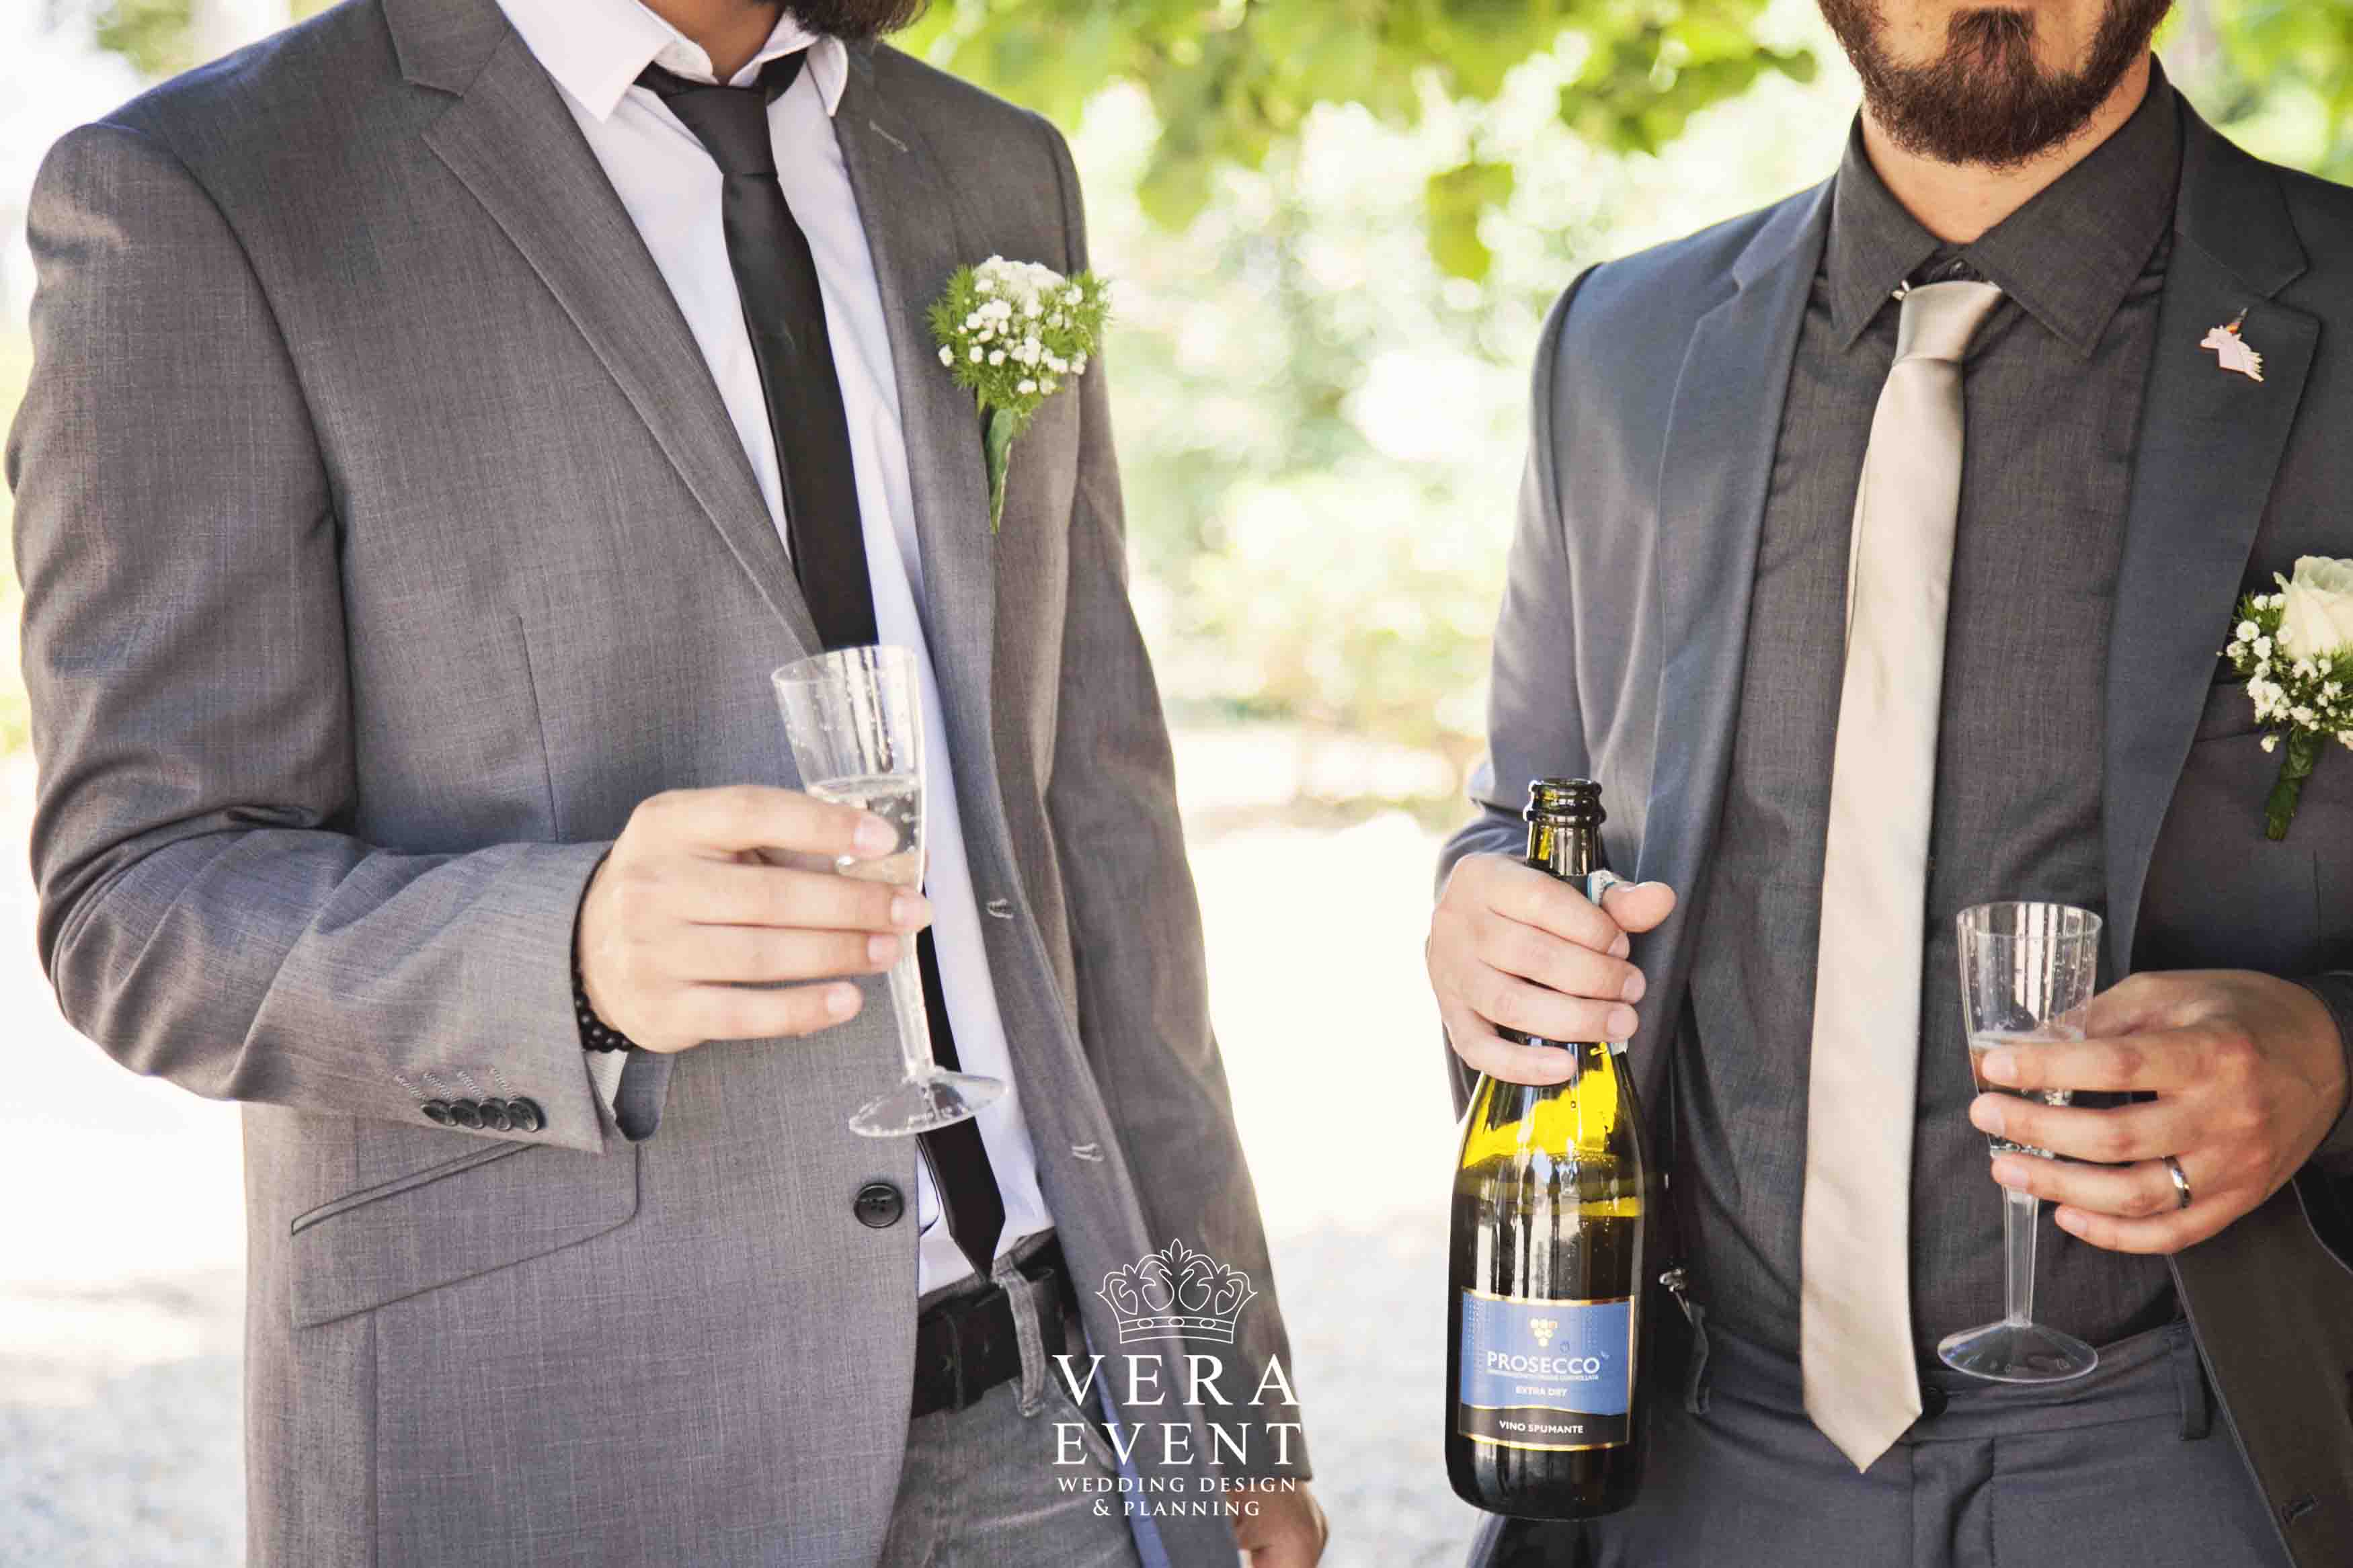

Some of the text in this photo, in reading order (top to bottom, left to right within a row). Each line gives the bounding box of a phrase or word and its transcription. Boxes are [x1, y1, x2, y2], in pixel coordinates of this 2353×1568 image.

[1487, 1350, 1600, 1374] PROSECCO
[1515, 1385, 1568, 1398] EXTRA DRY
[1499, 1419, 1584, 1434] VINO SPUMANTE
